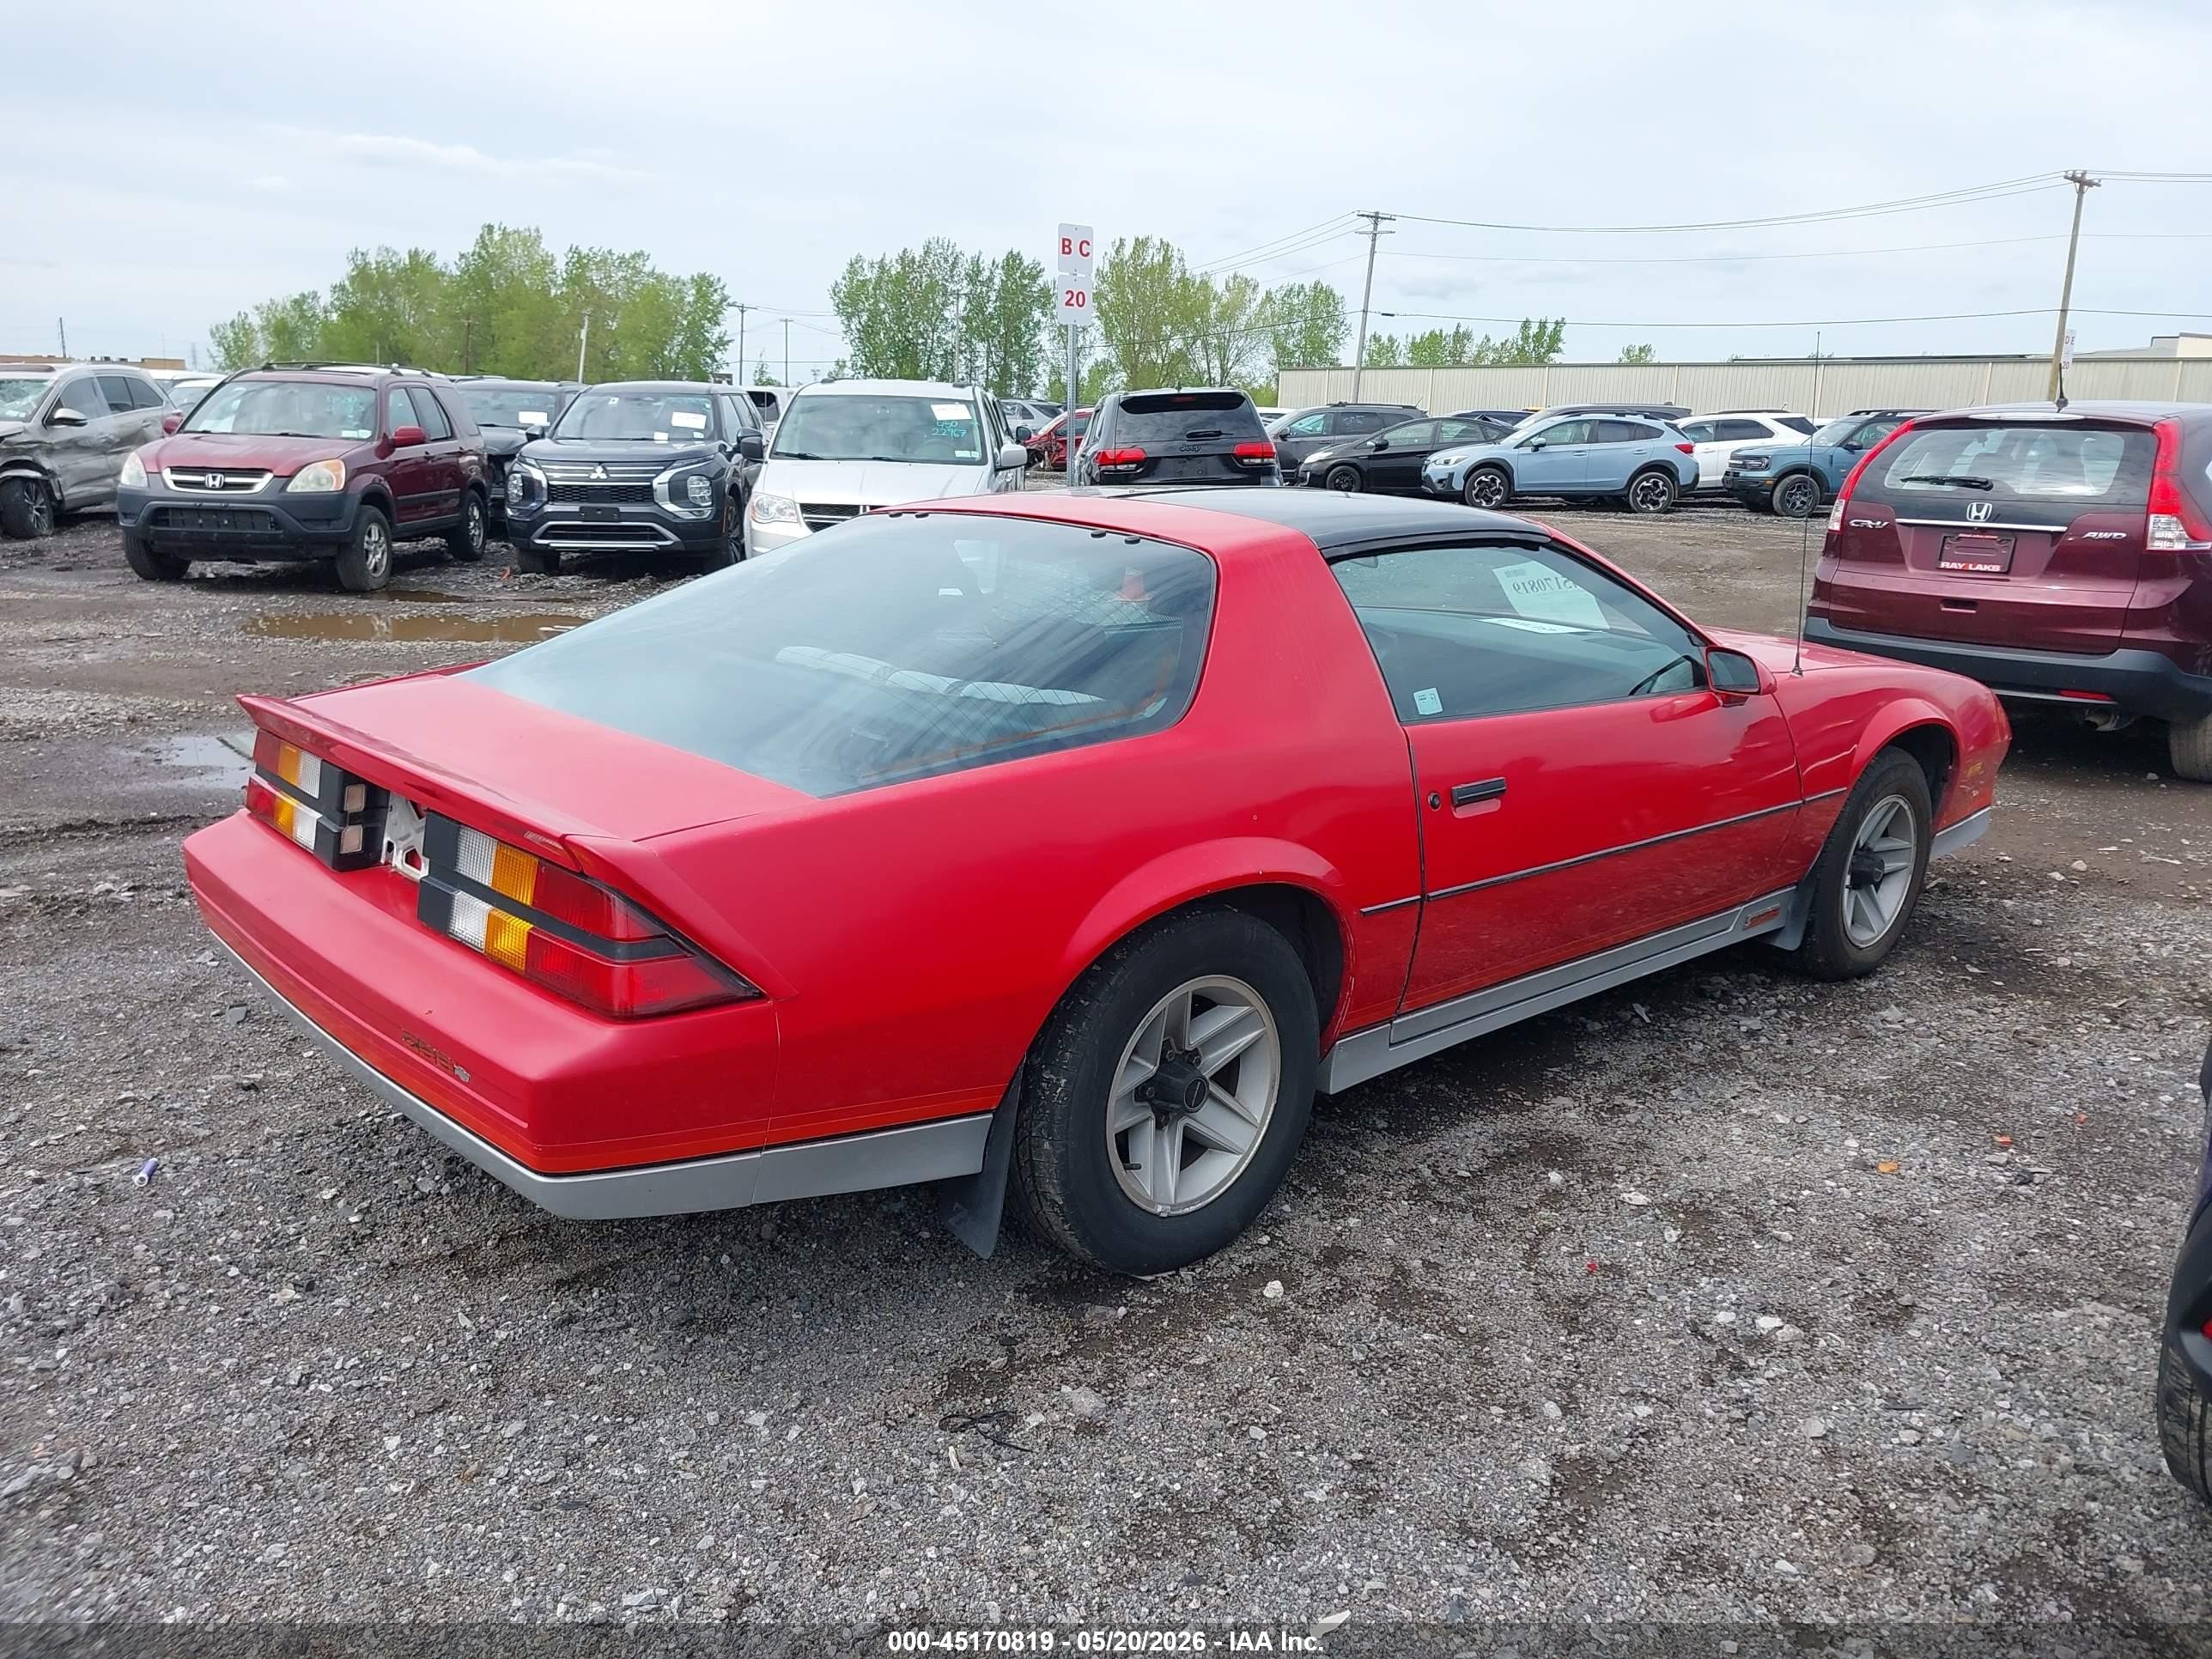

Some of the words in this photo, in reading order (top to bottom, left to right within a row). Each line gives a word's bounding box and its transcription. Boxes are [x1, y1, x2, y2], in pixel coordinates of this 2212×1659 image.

[1061, 238, 1073, 255] B
[1079, 240, 1091, 258] C
[1065, 289, 1085, 307] 20
[1179, 443, 1201, 453] Jeep
